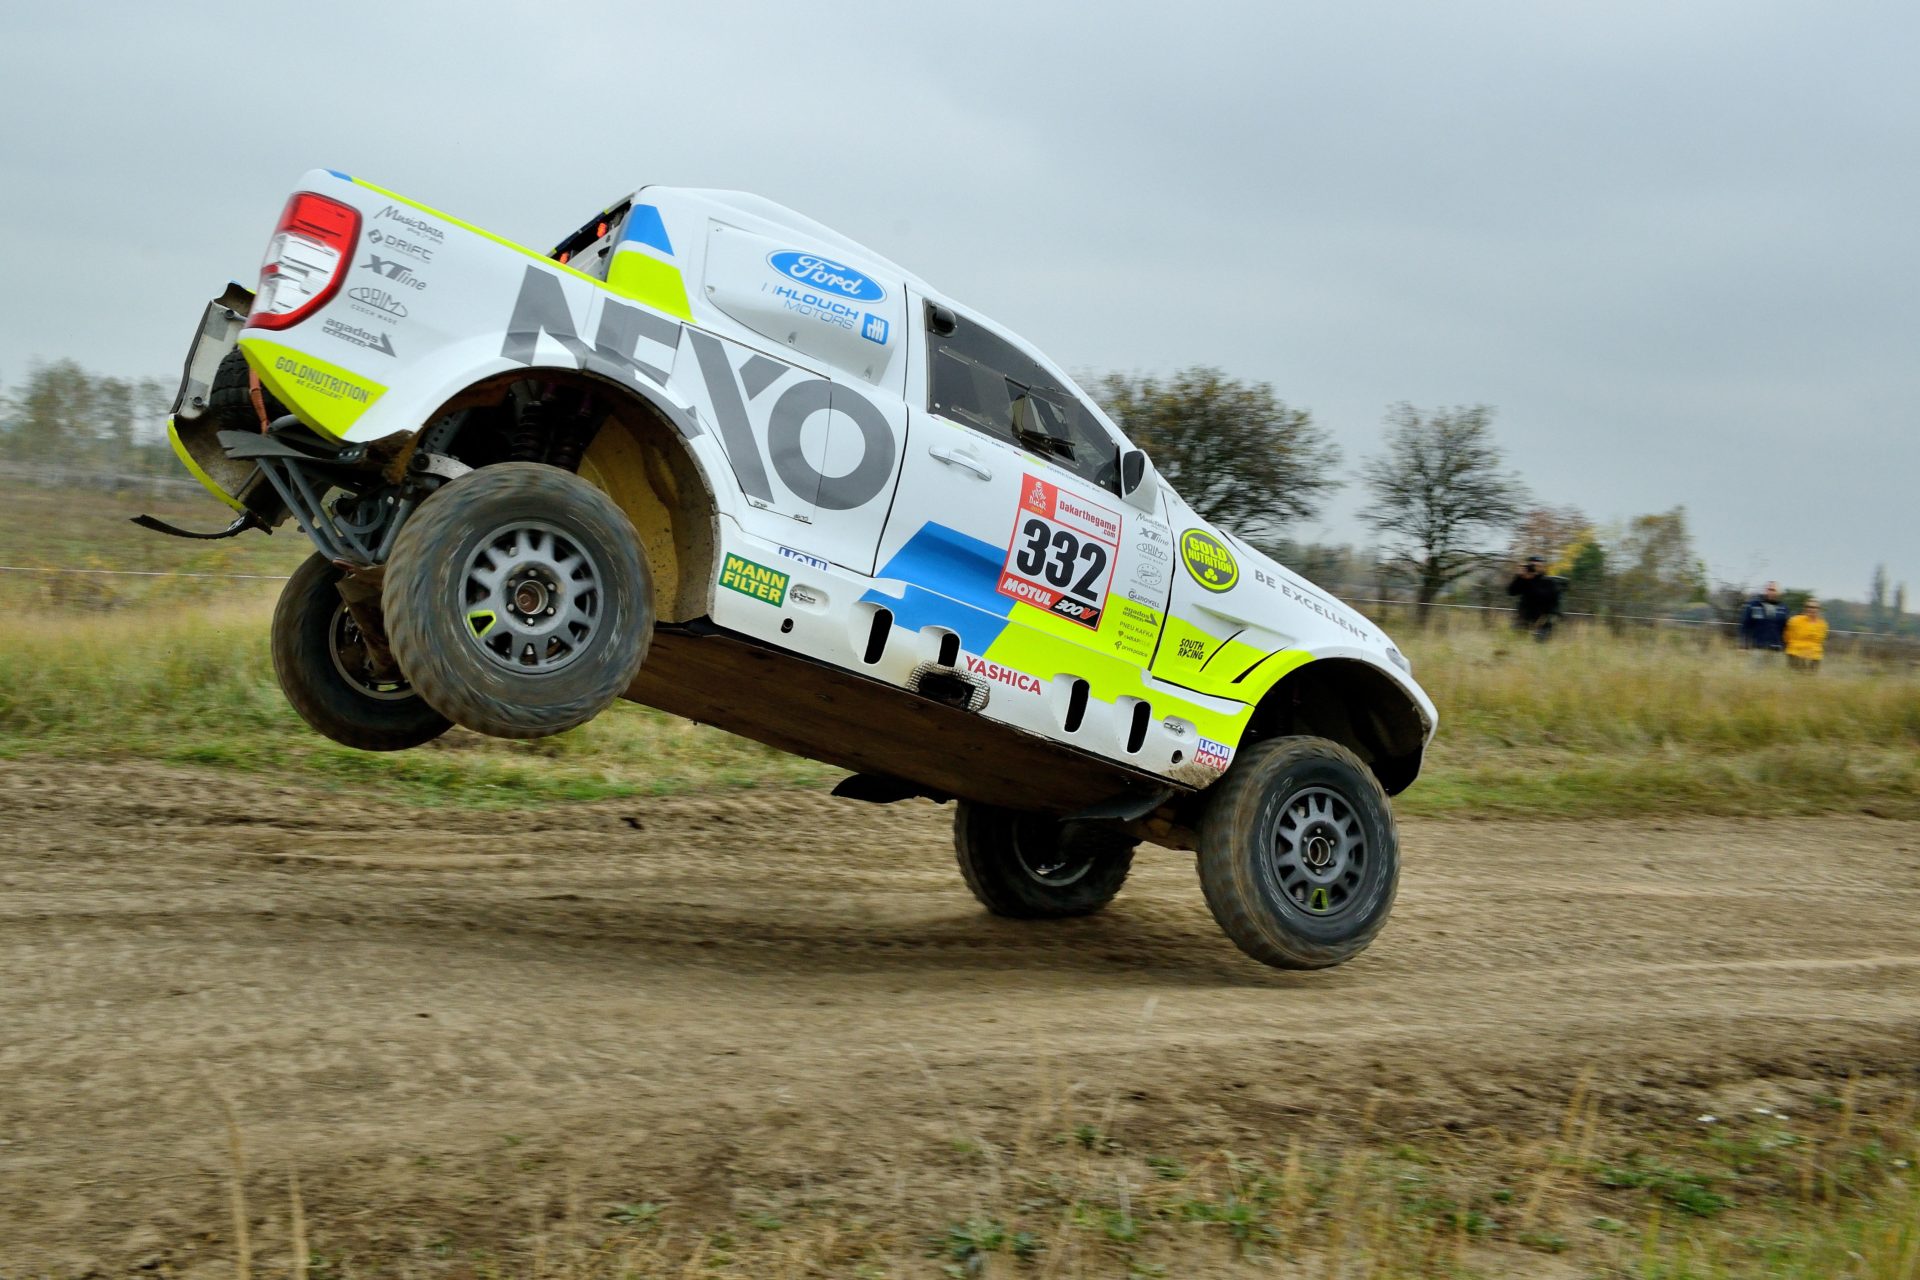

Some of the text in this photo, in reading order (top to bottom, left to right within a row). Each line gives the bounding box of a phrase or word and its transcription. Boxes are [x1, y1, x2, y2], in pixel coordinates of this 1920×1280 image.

[360, 253, 427, 291] XTline
[789, 255, 863, 295] Ford
[776, 286, 860, 320] HLOUCH
[784, 300, 855, 330] MOTORS
[325, 317, 379, 344] agados
[275, 356, 369, 403] GOLDNUTRITION
[1060, 500, 1117, 532] Dakarthegame
[1017, 518, 1107, 603] 332
[1188, 547, 1233, 575] NUTRITION
[1189, 537, 1228, 562] GOLD
[722, 571, 782, 604] FILTER
[726, 556, 786, 590] MANN
[1003, 577, 1052, 606] MOTUL
[1255, 569, 1369, 642] BE EXCELLENT
[1054, 598, 1098, 621] 300V
[1179, 638, 1205, 651] SOUTH
[965, 655, 1042, 696] YASHICA
[1194, 751, 1227, 770] MOLY
[1199, 739, 1230, 759] LIQUI
